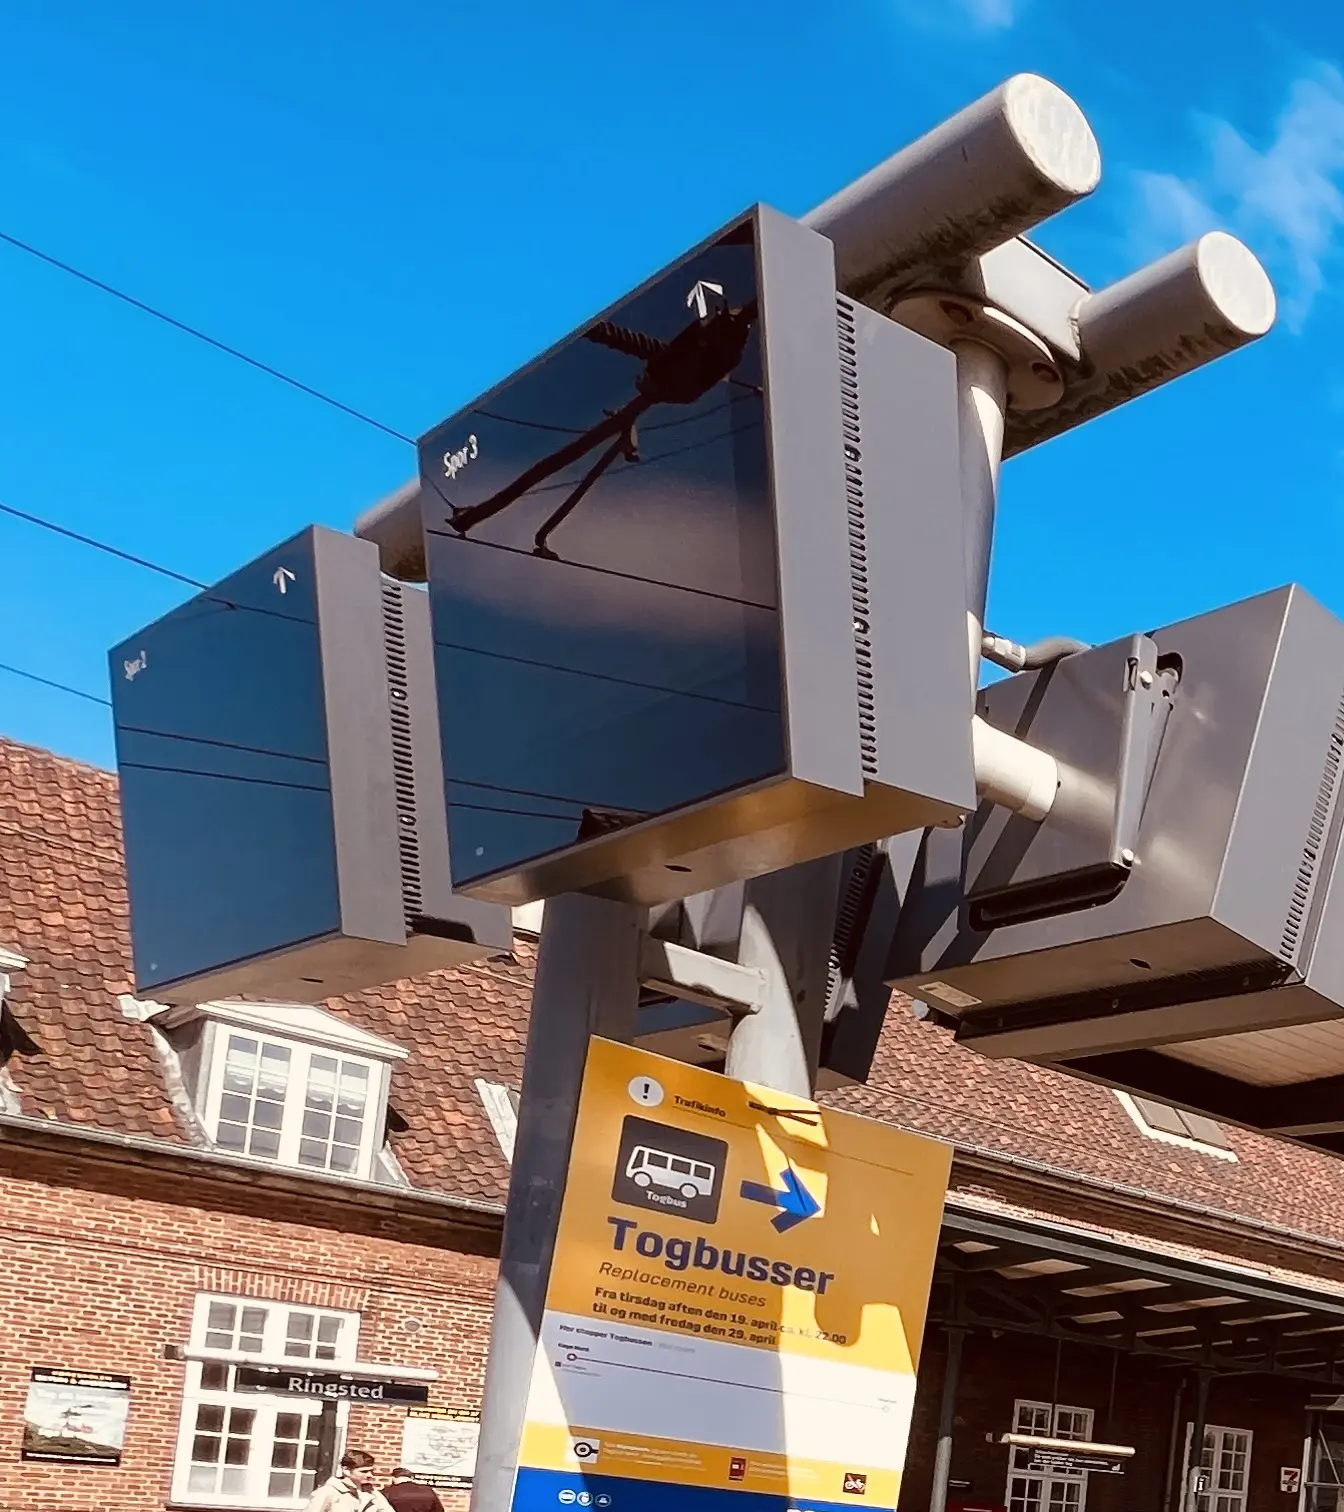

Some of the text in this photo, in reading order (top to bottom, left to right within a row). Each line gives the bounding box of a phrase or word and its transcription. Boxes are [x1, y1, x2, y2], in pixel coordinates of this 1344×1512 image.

[469, 434, 478, 459] 3
[674, 1095, 726, 1118] Trafikinfo
[646, 1189, 687, 1209] Togbus
[607, 1216, 835, 1295] Togbusser
[599, 1261, 767, 1308] Replacement buses
[593, 1302, 608, 1315] til
[610, 1306, 627, 1320] og
[629, 1309, 657, 1325] med
[659, 1314, 701, 1333] fredag
[703, 1322, 726, 1337] den
[749, 1332, 775, 1345] april
[595, 1287, 617, 1301] Fra
[620, 1290, 665, 1312] tirsdag
[668, 1301, 703, 1318] aften
[705, 1308, 727, 1323] den
[731, 1314, 750, 1326] 19.
[751, 1319, 778, 1332] april
[288, 1377, 384, 1400] Ringsted
